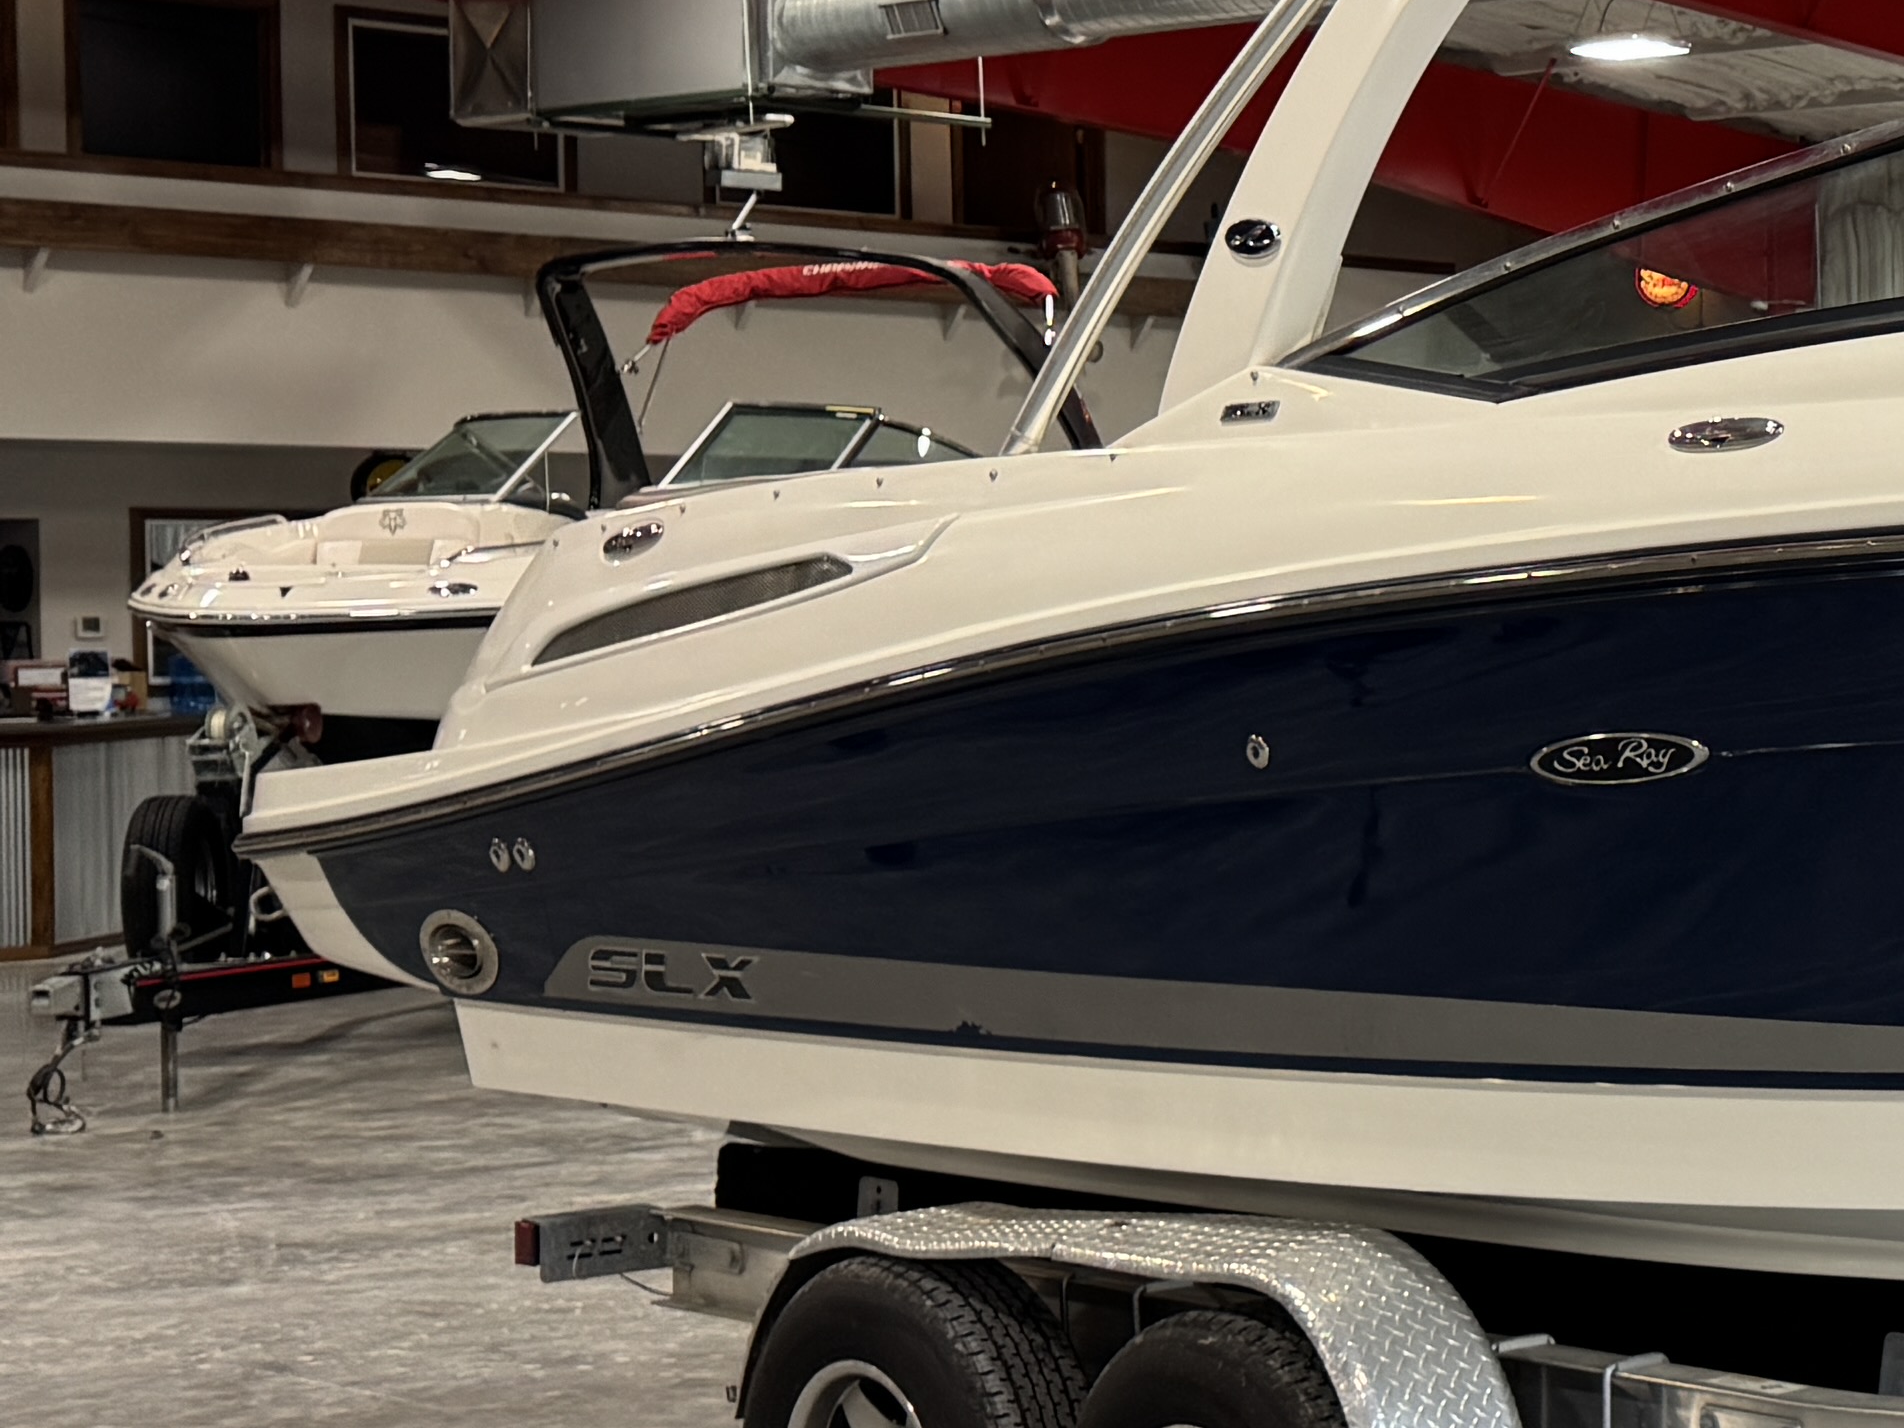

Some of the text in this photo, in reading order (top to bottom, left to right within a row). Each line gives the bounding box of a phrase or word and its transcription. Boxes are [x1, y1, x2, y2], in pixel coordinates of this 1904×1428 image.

[1553, 738, 1676, 773] Sea Ray
[588, 946, 760, 1004] SLX
